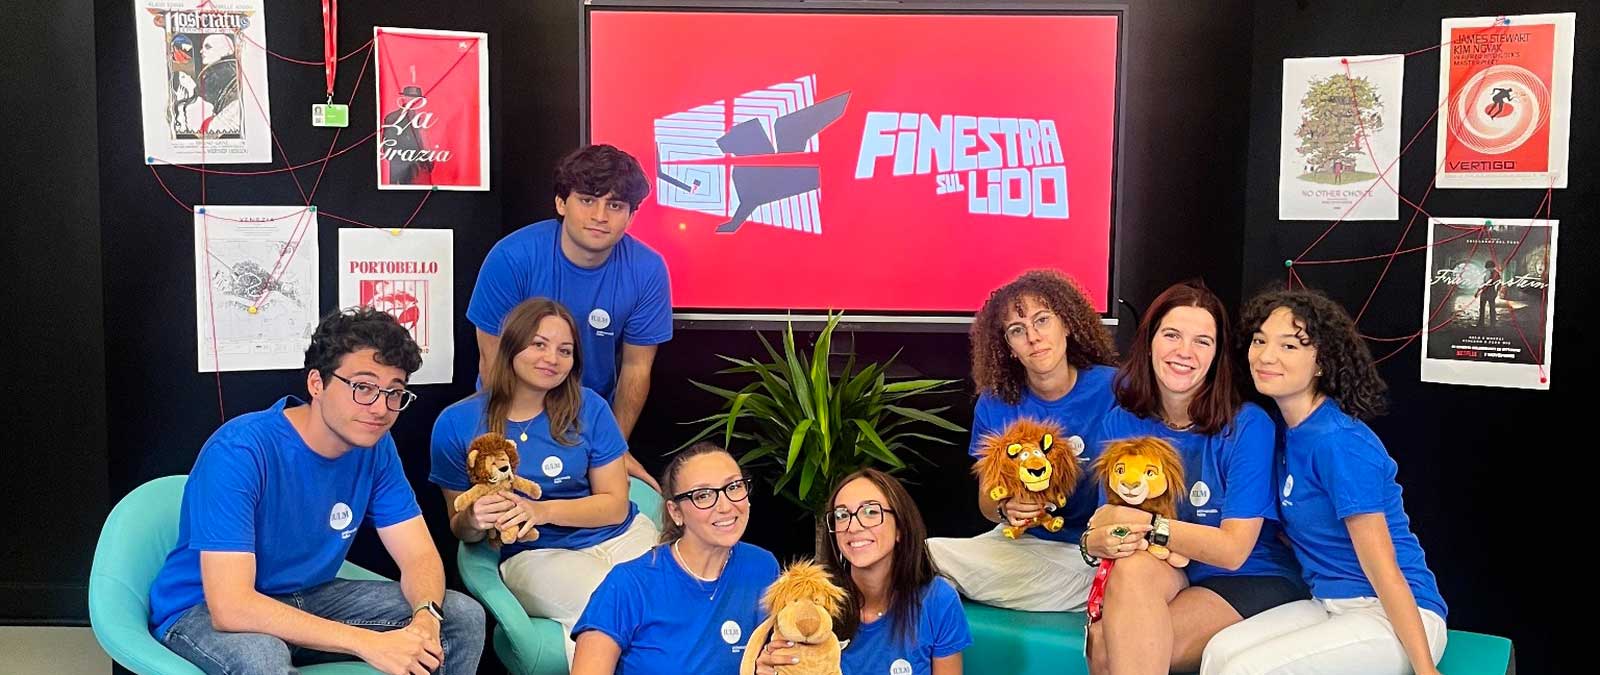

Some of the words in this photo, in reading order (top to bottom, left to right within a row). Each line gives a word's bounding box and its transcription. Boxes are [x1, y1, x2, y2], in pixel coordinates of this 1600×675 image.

[1454, 34, 1488, 44] JAMES
[1490, 33, 1531, 43] STEWART
[1453, 45, 1471, 54] KIM
[1474, 44, 1502, 53] NOVAK
[382, 97, 438, 135] La
[379, 139, 452, 162] Grazia
[1449, 161, 1515, 170] VERTIGO
[936, 173, 964, 194] SUL
[350, 260, 438, 274] PORTOBELLO
